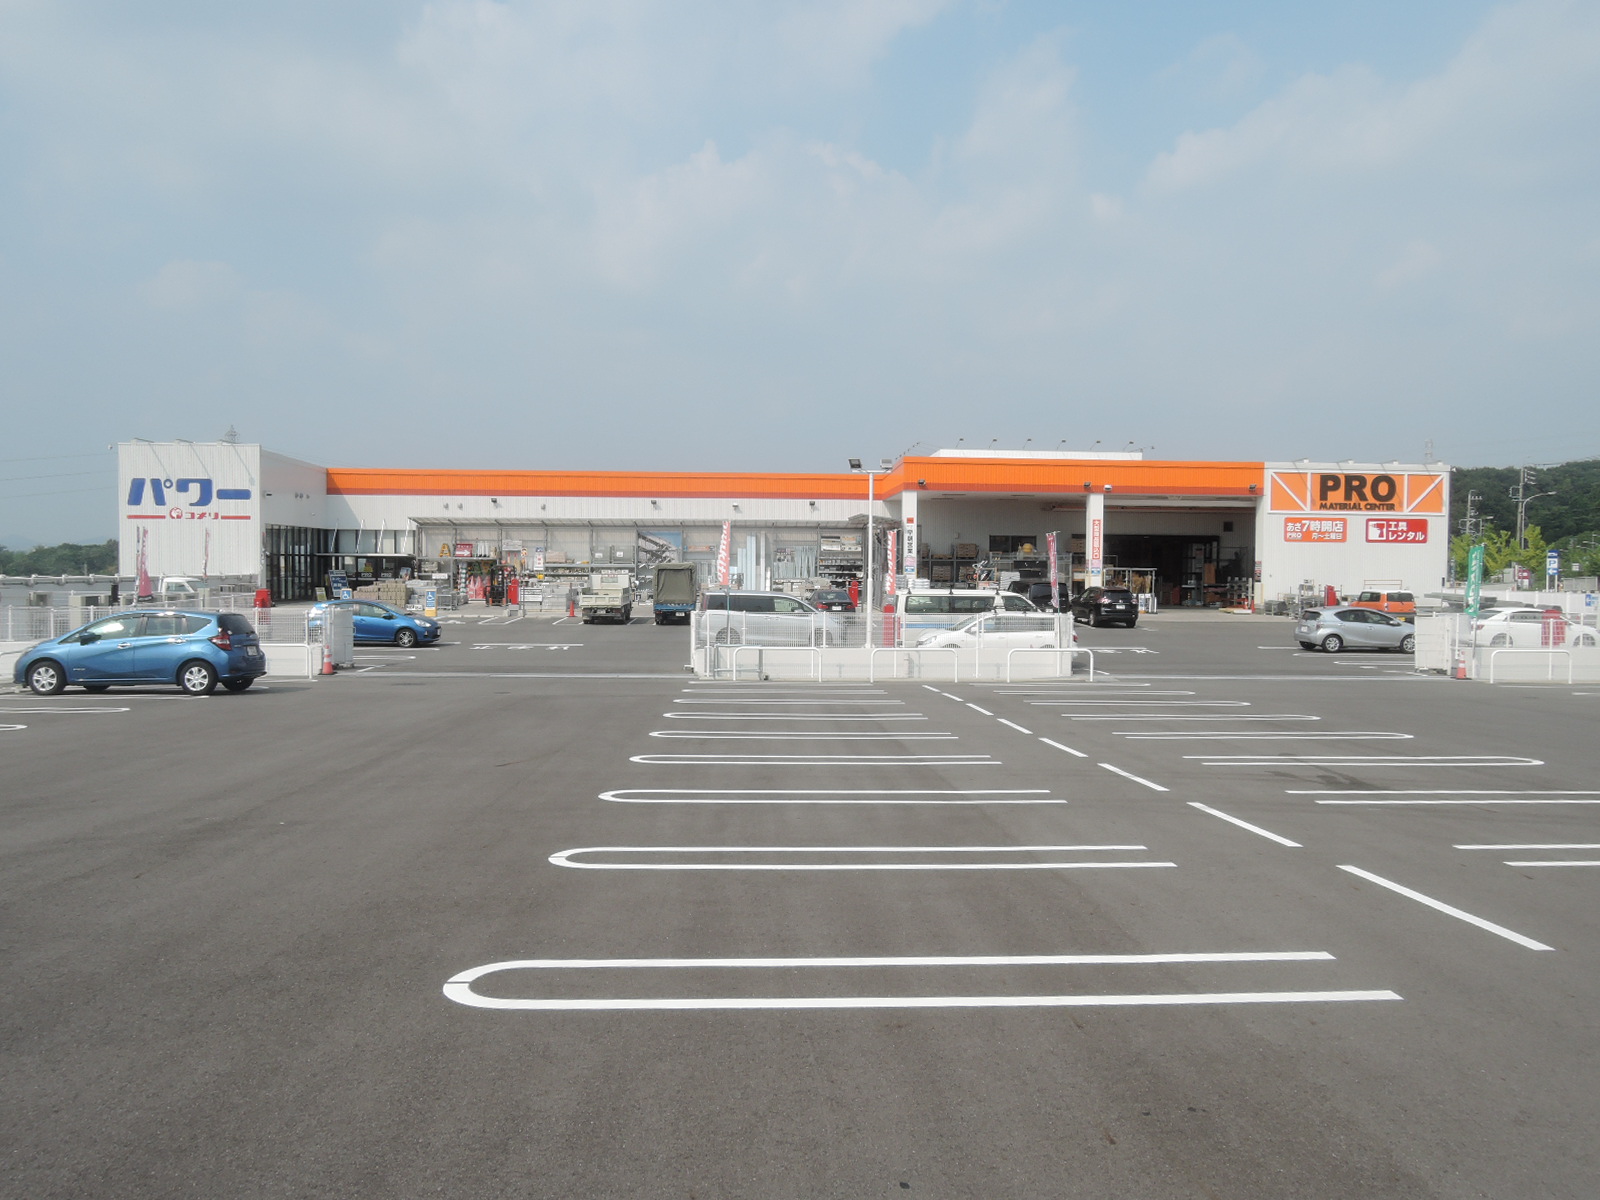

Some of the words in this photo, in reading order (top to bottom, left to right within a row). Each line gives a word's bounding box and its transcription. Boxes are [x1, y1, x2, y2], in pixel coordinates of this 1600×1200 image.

[127, 477, 251, 506] パワー
[1320, 474, 1396, 502] PRO
[1320, 503, 1362, 511] MATERIAL
[1364, 503, 1396, 511] CENTER
[185, 511, 219, 519] コメリ
[1286, 520, 1344, 532] あさ7時開店
[1388, 521, 1407, 531] 工具
[1388, 531, 1425, 541] レンタル
